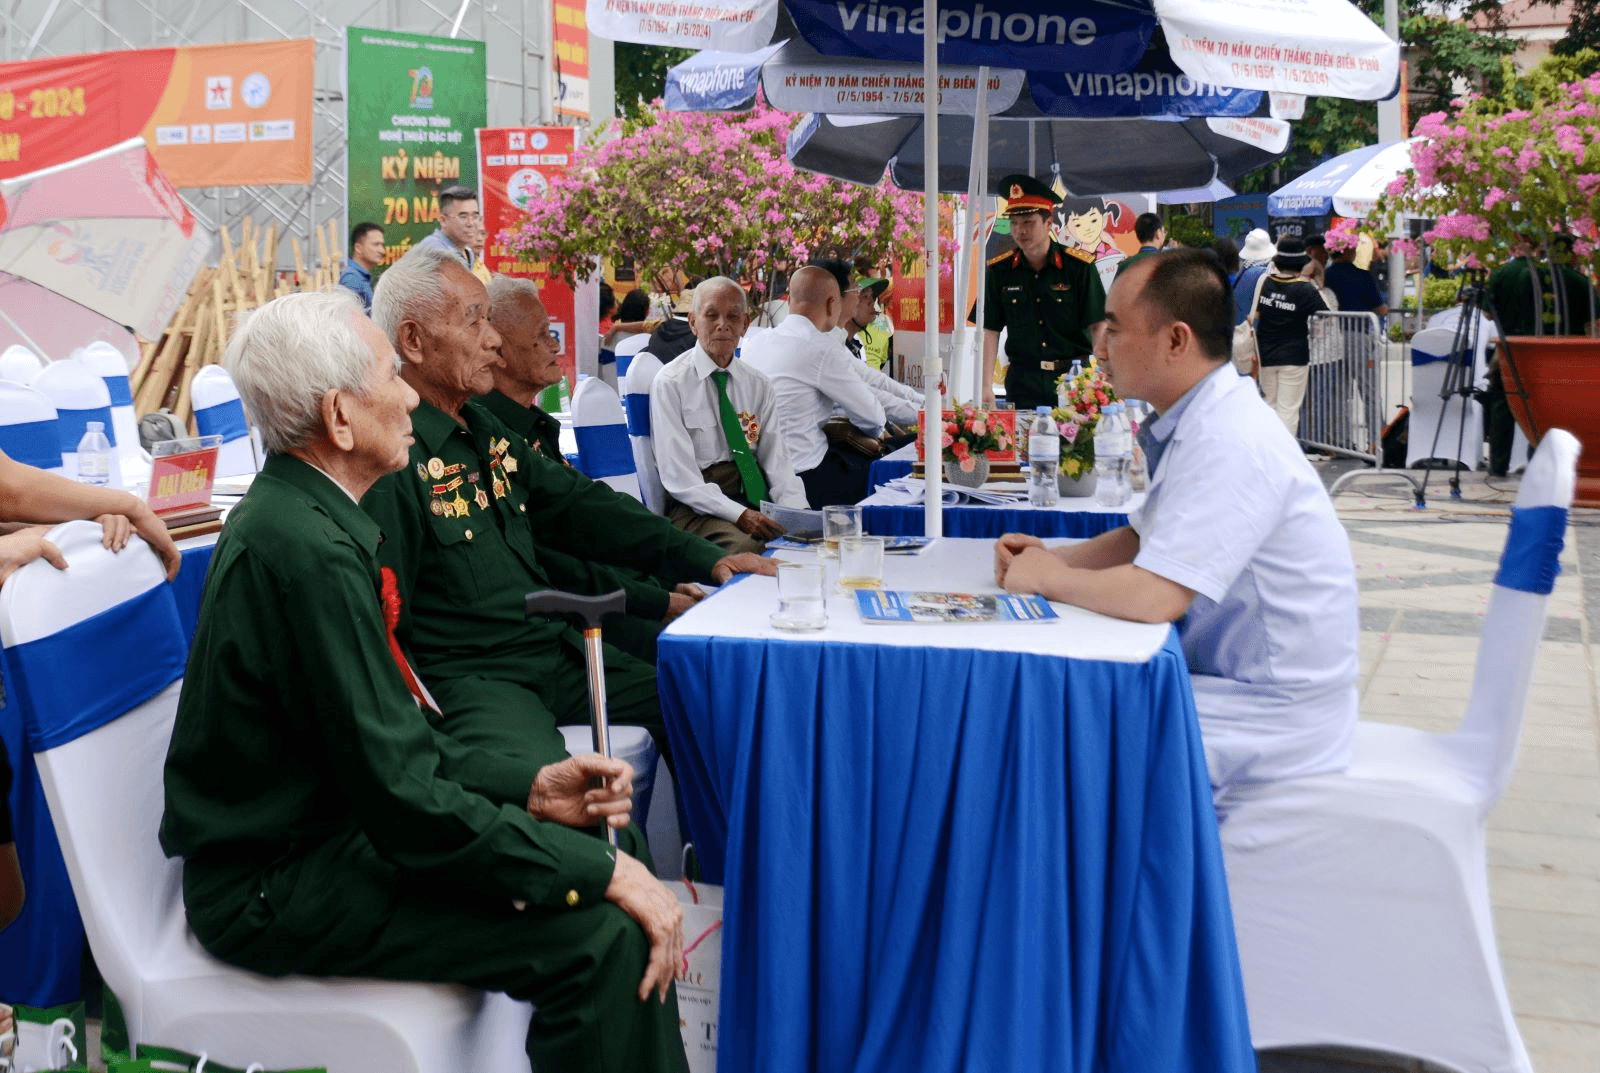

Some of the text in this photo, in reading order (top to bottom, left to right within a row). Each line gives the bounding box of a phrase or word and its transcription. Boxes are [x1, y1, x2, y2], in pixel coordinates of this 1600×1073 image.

[837, 0, 1097, 46] vinaphone
[1217, 41, 1228, 56] 70
[680, 64, 744, 97] vinaphone
[800, 73, 822, 90] NIỆM
[825, 76, 836, 87] 70
[839, 74, 859, 88] NĂM
[862, 73, 890, 88] CHIẾN
[953, 75, 976, 90] BIÊN
[30, 86, 86, 118] 2024
[837, 90, 883, 104] (7/5/1954
[893, 91, 943, 105] 7/5/20)
[381, 148, 460, 184] KỶ NIỆM
[383, 190, 441, 225] 70 NĂ
